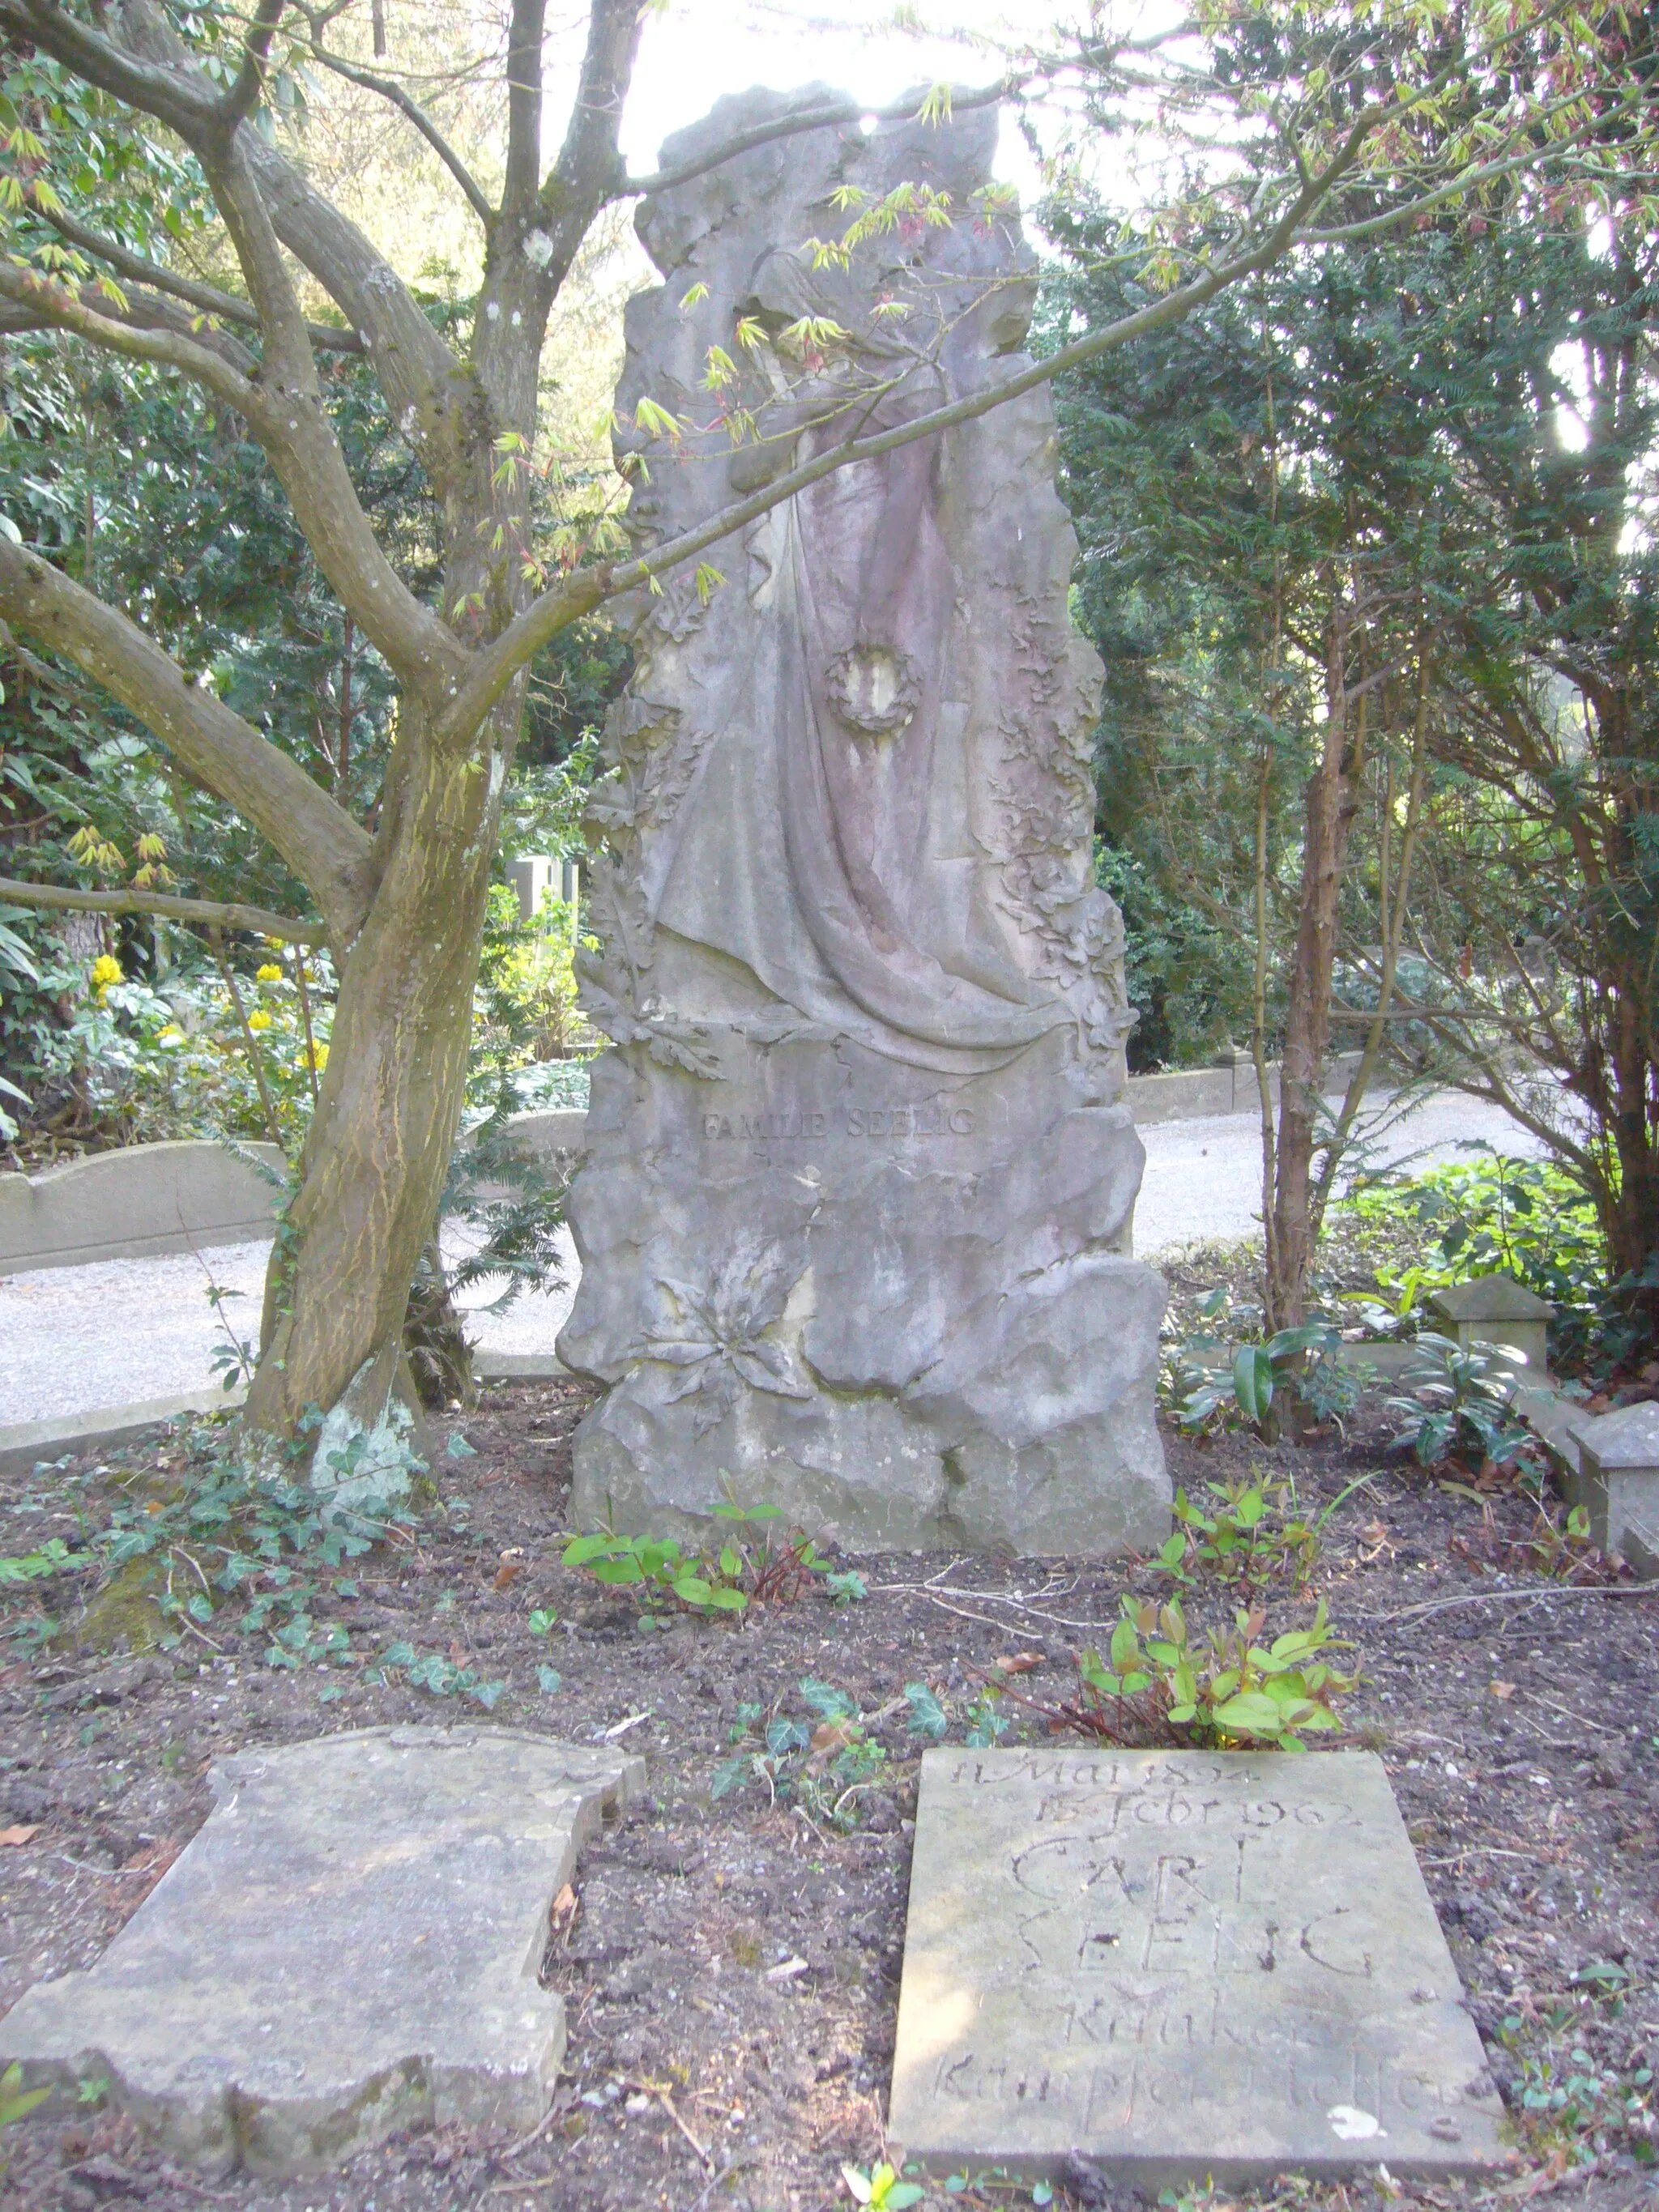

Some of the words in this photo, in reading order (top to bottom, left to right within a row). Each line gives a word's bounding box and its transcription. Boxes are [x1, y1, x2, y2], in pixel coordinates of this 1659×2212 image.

[847, 1106, 977, 1137] SEELIG
[983, 1753, 1120, 1784] Mai
[1239, 1800, 1363, 1829] 1962
[1009, 1832, 1277, 1905] CARL
[1016, 1905, 1372, 1980] SEELIG
